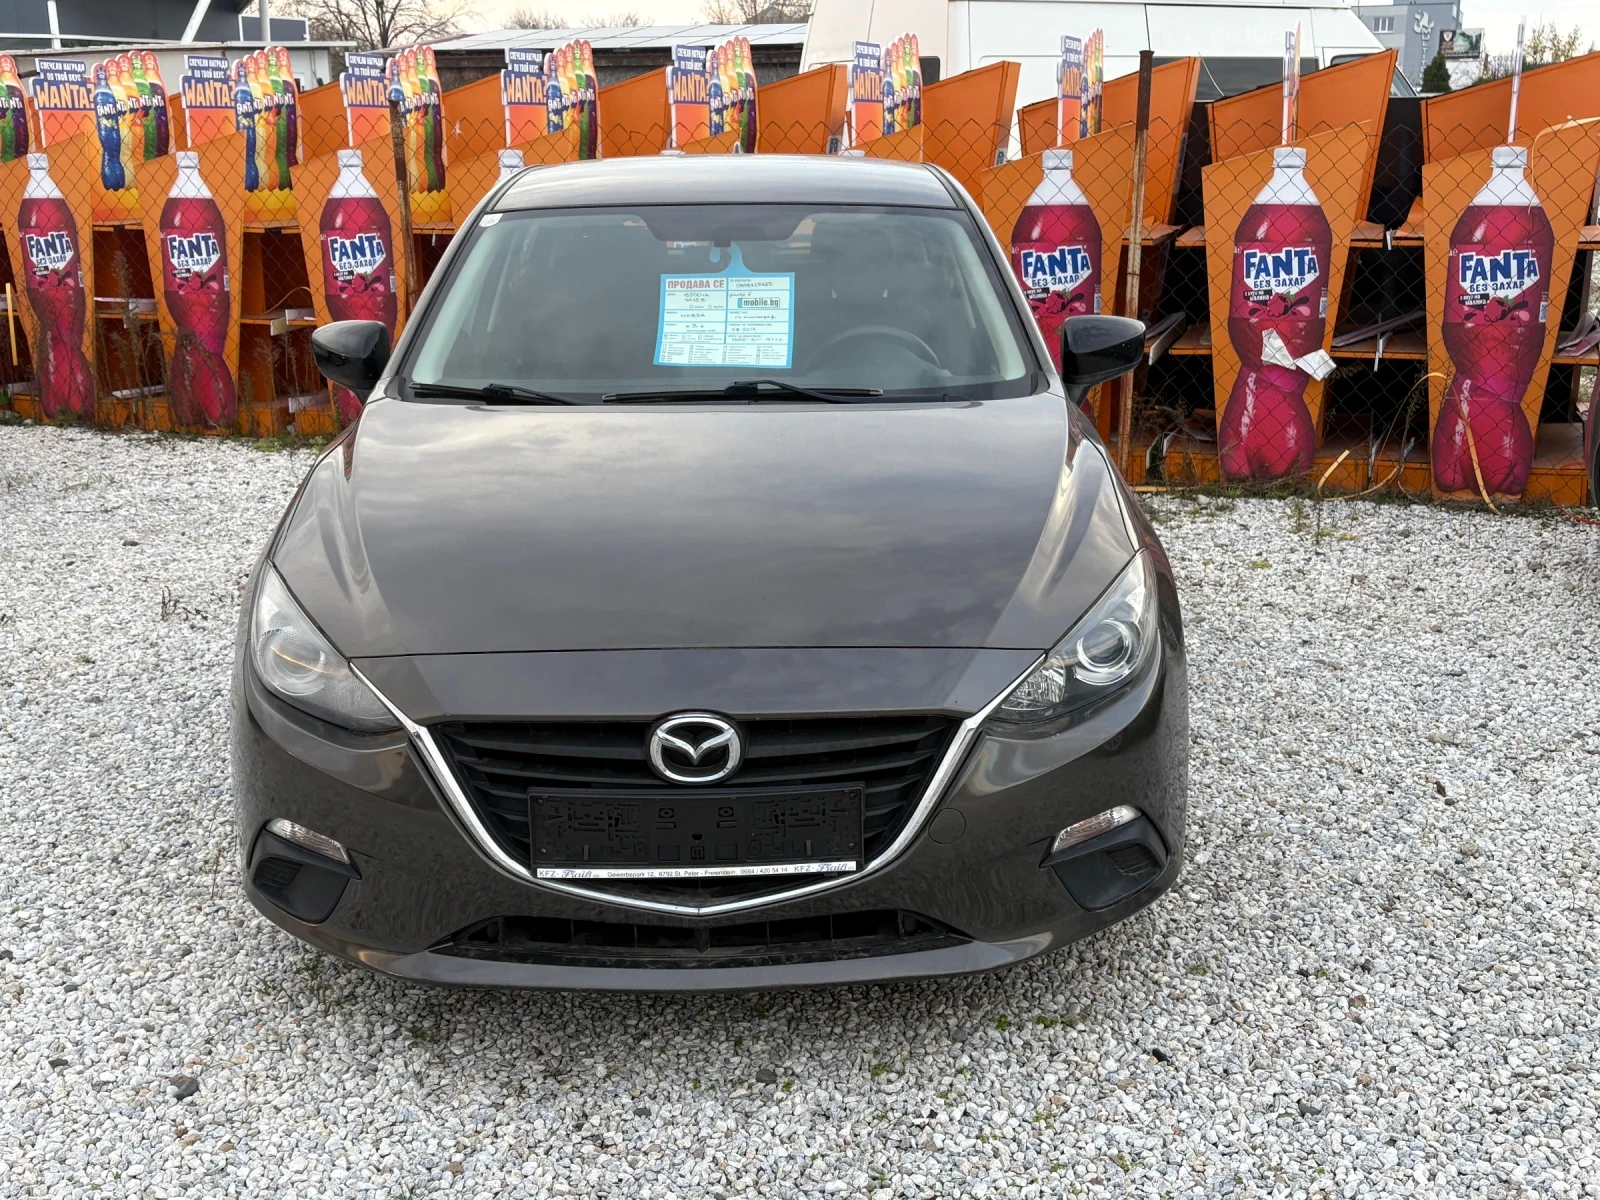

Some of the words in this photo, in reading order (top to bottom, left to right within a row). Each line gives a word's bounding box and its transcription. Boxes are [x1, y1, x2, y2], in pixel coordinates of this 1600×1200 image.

[41, 61, 61, 70] СПЕЧЕЛИ
[63, 62, 85, 72] НАГРАДИ
[189, 58, 208, 67] СПЕЧЕЛИ
[209, 60, 228, 69] НАГРАДИ
[55, 72, 68, 81] ТВОЙ
[201, 69, 212, 78] ТВОЙ
[214, 70, 224, 78] ВКУС
[36, 82, 94, 109] WANTA?
[184, 79, 236, 106] WANTA?
[10, 97, 23, 108] NTA
[128, 96, 138, 109] NTA
[140, 95, 152, 106] NTA
[152, 95, 164, 107] NTA
[253, 98, 262, 109] NTA
[264, 96, 273, 107] NTA
[274, 93, 284, 105] NTA
[284, 93, 294, 105] NTA
[97, 103, 115, 116] FANTA
[116, 100, 126, 112] NTA
[237, 102, 252, 114] FANTA
[27, 233, 73, 258] FANTA
[168, 234, 219, 260] FANTA
[329, 235, 384, 262] FANTA
[48, 255, 67, 264] ЗАХАР
[192, 258, 212, 266] ЗАХАР
[339, 262, 352, 270] БЕЗ
[354, 259, 376, 268] ЗАХАР
[1022, 248, 1090, 278] FANTA
[1245, 249, 1317, 280] FANTA
[1461, 252, 1538, 284] FANTA
[667, 280, 710, 289] ПРОДАВА
[713, 280, 725, 288] СЕ
[1032, 279, 1047, 287] БЕЗ
[1052, 275, 1079, 285] ЗАХАР
[1254, 280, 1271, 288] БЕЗ
[1275, 277, 1305, 287] ЗАХАР
[1470, 284, 1488, 292] БЕЗ
[1492, 281, 1524, 290] ЗАХАР
